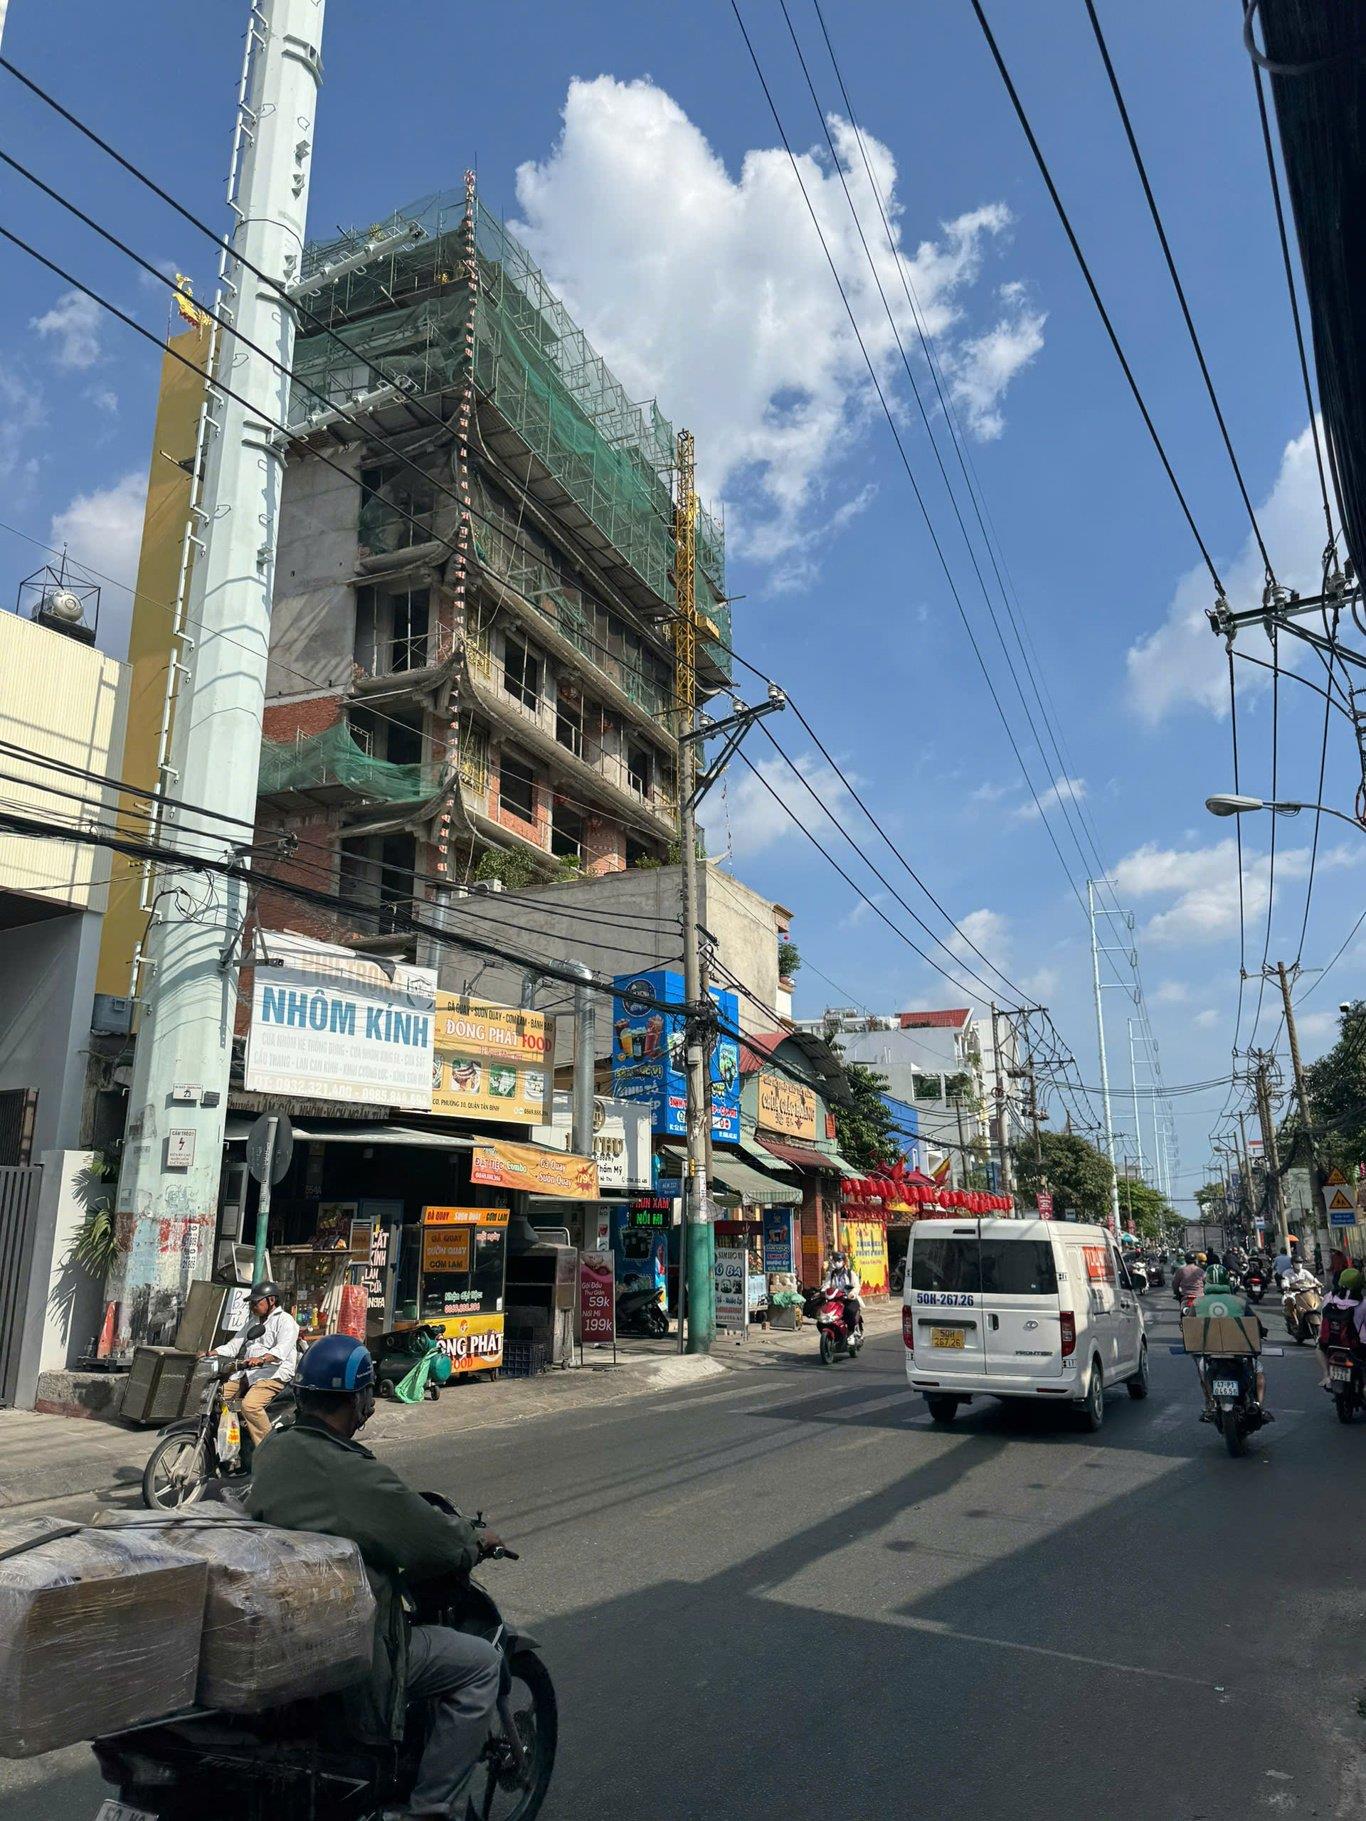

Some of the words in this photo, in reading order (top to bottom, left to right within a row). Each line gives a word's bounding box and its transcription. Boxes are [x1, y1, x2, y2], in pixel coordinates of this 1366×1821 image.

[261, 986, 357, 1036] NHÔM
[365, 1002, 429, 1048] KÍNH
[446, 1017, 486, 1040] ĐÔNG
[488, 1026, 518, 1046] PHÁT
[521, 1033, 552, 1052] FOOD
[588, 1296, 610, 1307] 59k
[916, 1292, 974, 1307] 50H-267.26
[584, 1318, 613, 1331] 199k
[940, 1329, 955, 1339] 50H
[436, 1334, 467, 1356] ÔNG
[470, 1330, 504, 1354] PHÁT
[452, 1359, 473, 1370] OOD
